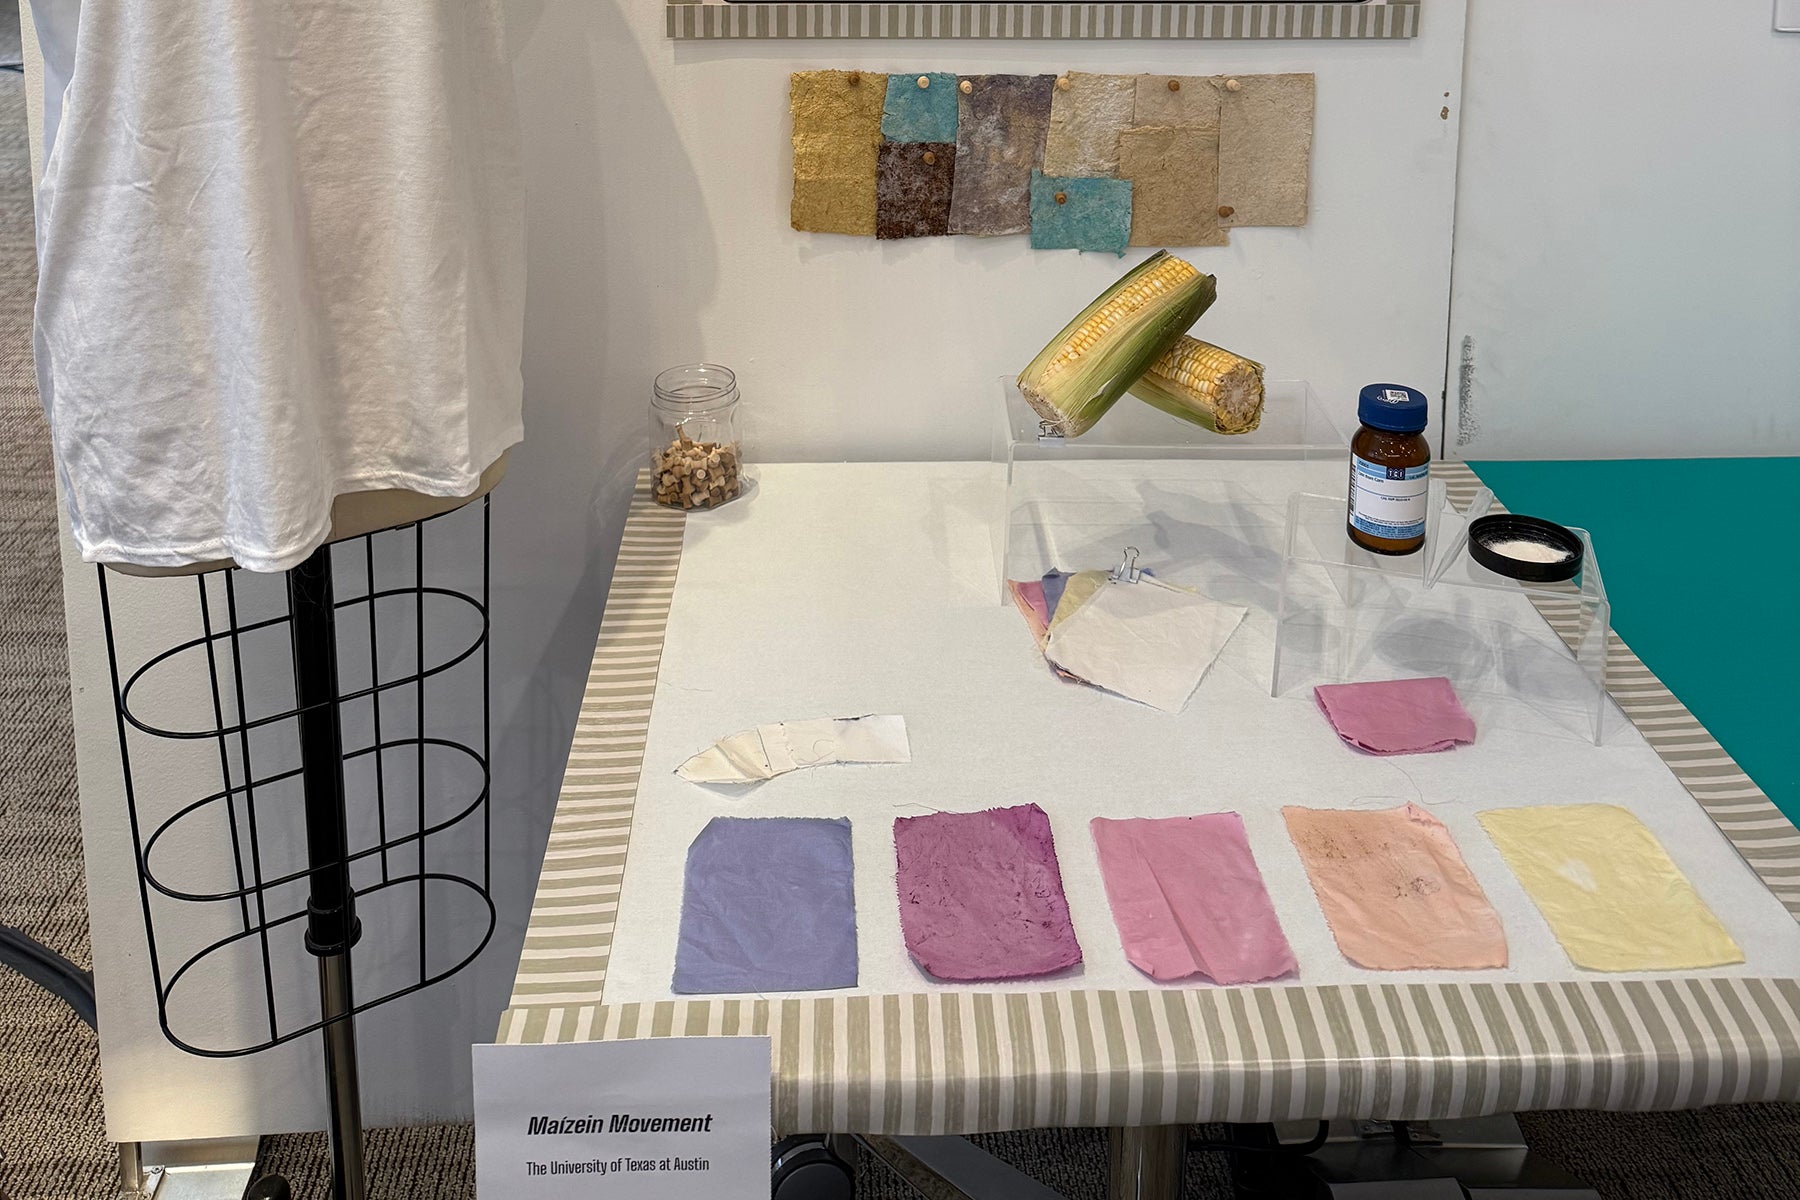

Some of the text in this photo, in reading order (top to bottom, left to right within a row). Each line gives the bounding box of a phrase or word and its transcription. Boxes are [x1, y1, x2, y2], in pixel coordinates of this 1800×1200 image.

[527, 1114, 713, 1135] Maízein Movement
[526, 1157, 709, 1176] The University of Texas at Austin
